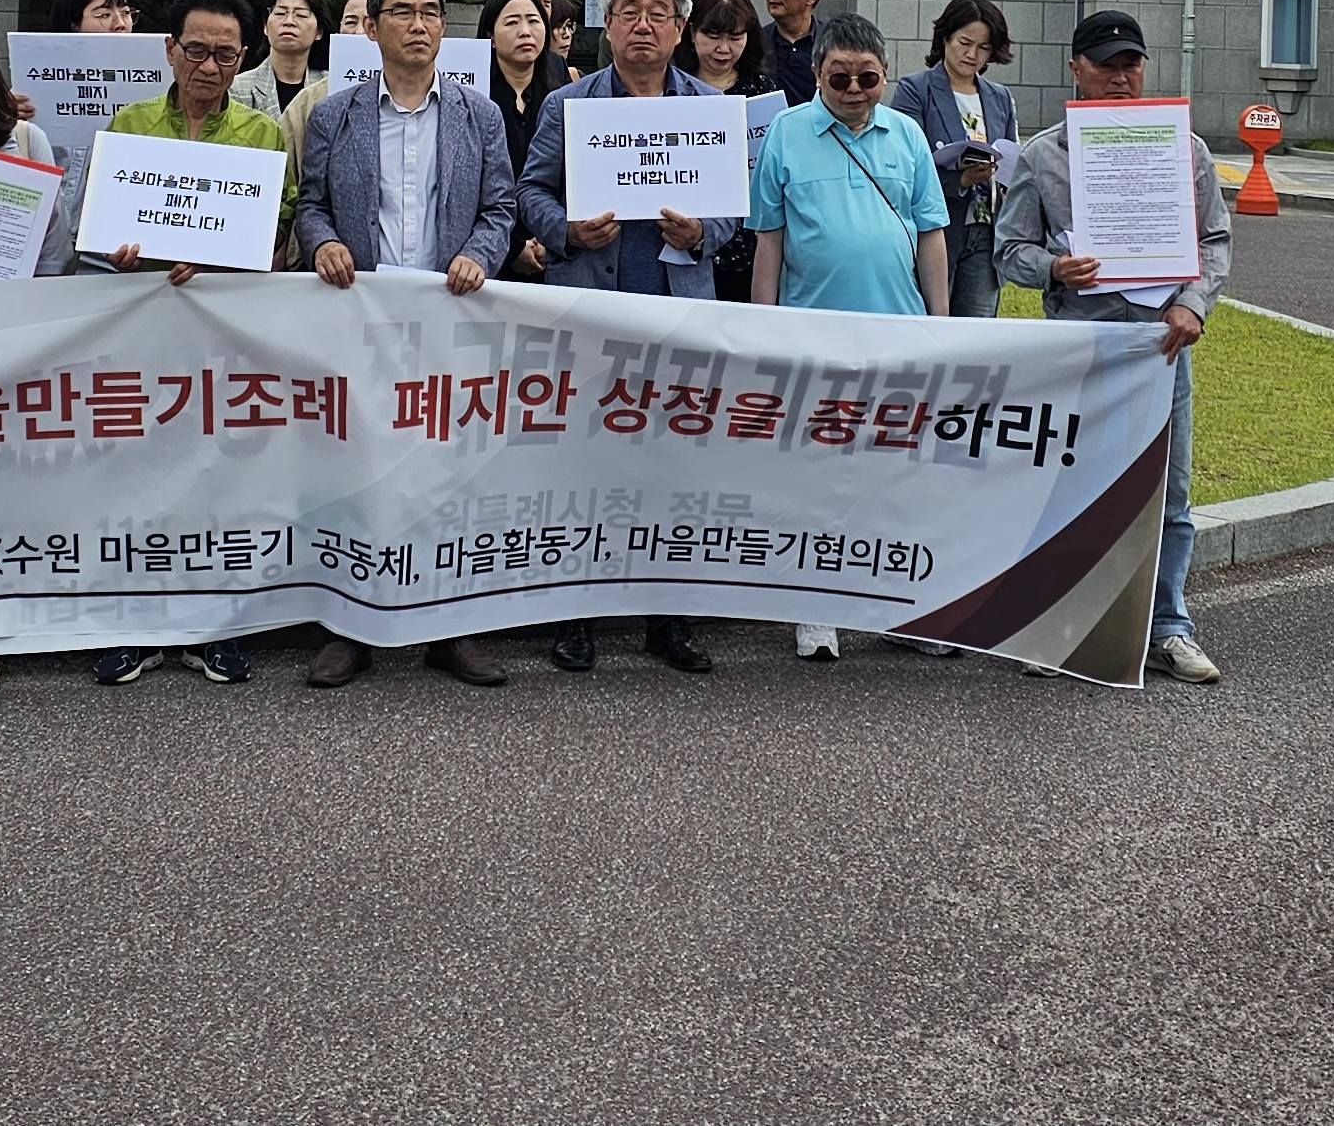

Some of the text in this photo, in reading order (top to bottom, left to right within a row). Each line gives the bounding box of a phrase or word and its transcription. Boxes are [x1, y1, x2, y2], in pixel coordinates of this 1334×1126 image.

[27, 68, 161, 82] 수원마을만들기조례
[78, 86, 107, 99] 폐지
[56, 103, 128, 116] 반대합니
[588, 132, 725, 148] 수원마을만들기조례
[640, 152, 669, 165] 폐지
[114, 170, 260, 199] 수원마을만들기조례
[618, 170, 698, 185] 반대합니다!
[165, 194, 198, 209] 폐지
[138, 210, 224, 230] 반대합니다!
[395, 371, 574, 440] 폐지안
[598, 377, 786, 440] 상정을
[808, 400, 1080, 467] 중단하라!
[101, 526, 292, 572] 마을만들기
[306, 529, 419, 589] 공동체,
[436, 524, 611, 578] 마을활동가,
[622, 524, 933, 589] 마을만들기협의회)
